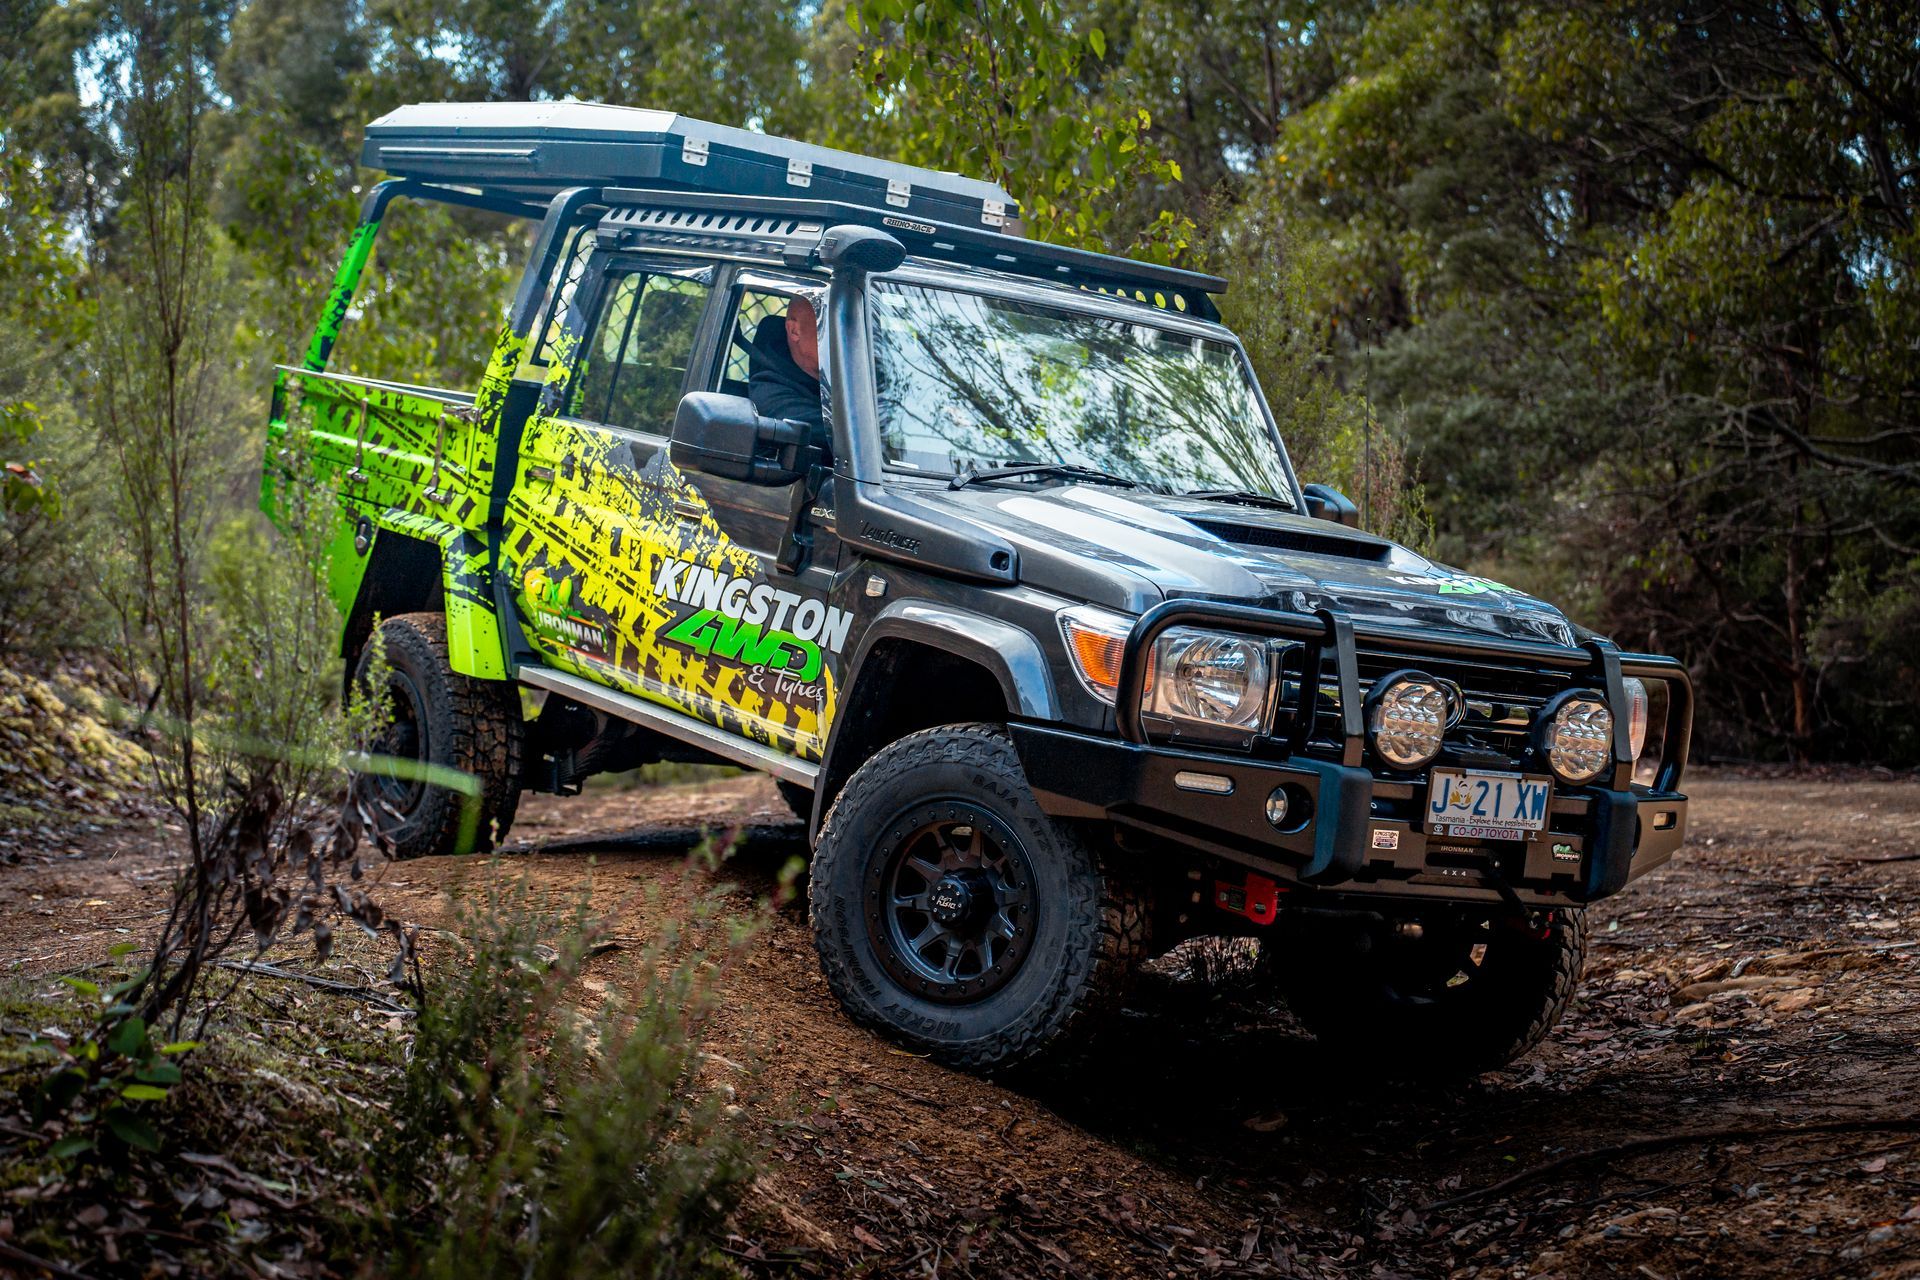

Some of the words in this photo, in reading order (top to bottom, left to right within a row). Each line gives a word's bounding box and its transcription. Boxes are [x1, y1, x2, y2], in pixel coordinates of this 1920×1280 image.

[886, 218, 932, 233] RHINO-RACK
[653, 557, 855, 654] KINGSTON
[538, 611, 603, 647] IRONMAN
[664, 608, 822, 683] 4WD
[748, 665, 766, 693] &
[771, 667, 824, 704] Tyres
[1432, 778, 1451, 813] J
[1472, 780, 1503, 817] 21
[1513, 783, 1548, 820] XW
[1435, 814, 1465, 823] Tasmania
[1469, 816, 1490, 825] Explore
[1492, 816, 1503, 825] the
[1504, 818, 1537, 829] possibilities
[1452, 826, 1484, 837] CO-OP
[1485, 828, 1519, 839] TOYOTA
[1440, 845, 1474, 853] IRONMAN
[833, 895, 882, 1001] THOMPSON
[882, 1003, 961, 1037] MICKEY
